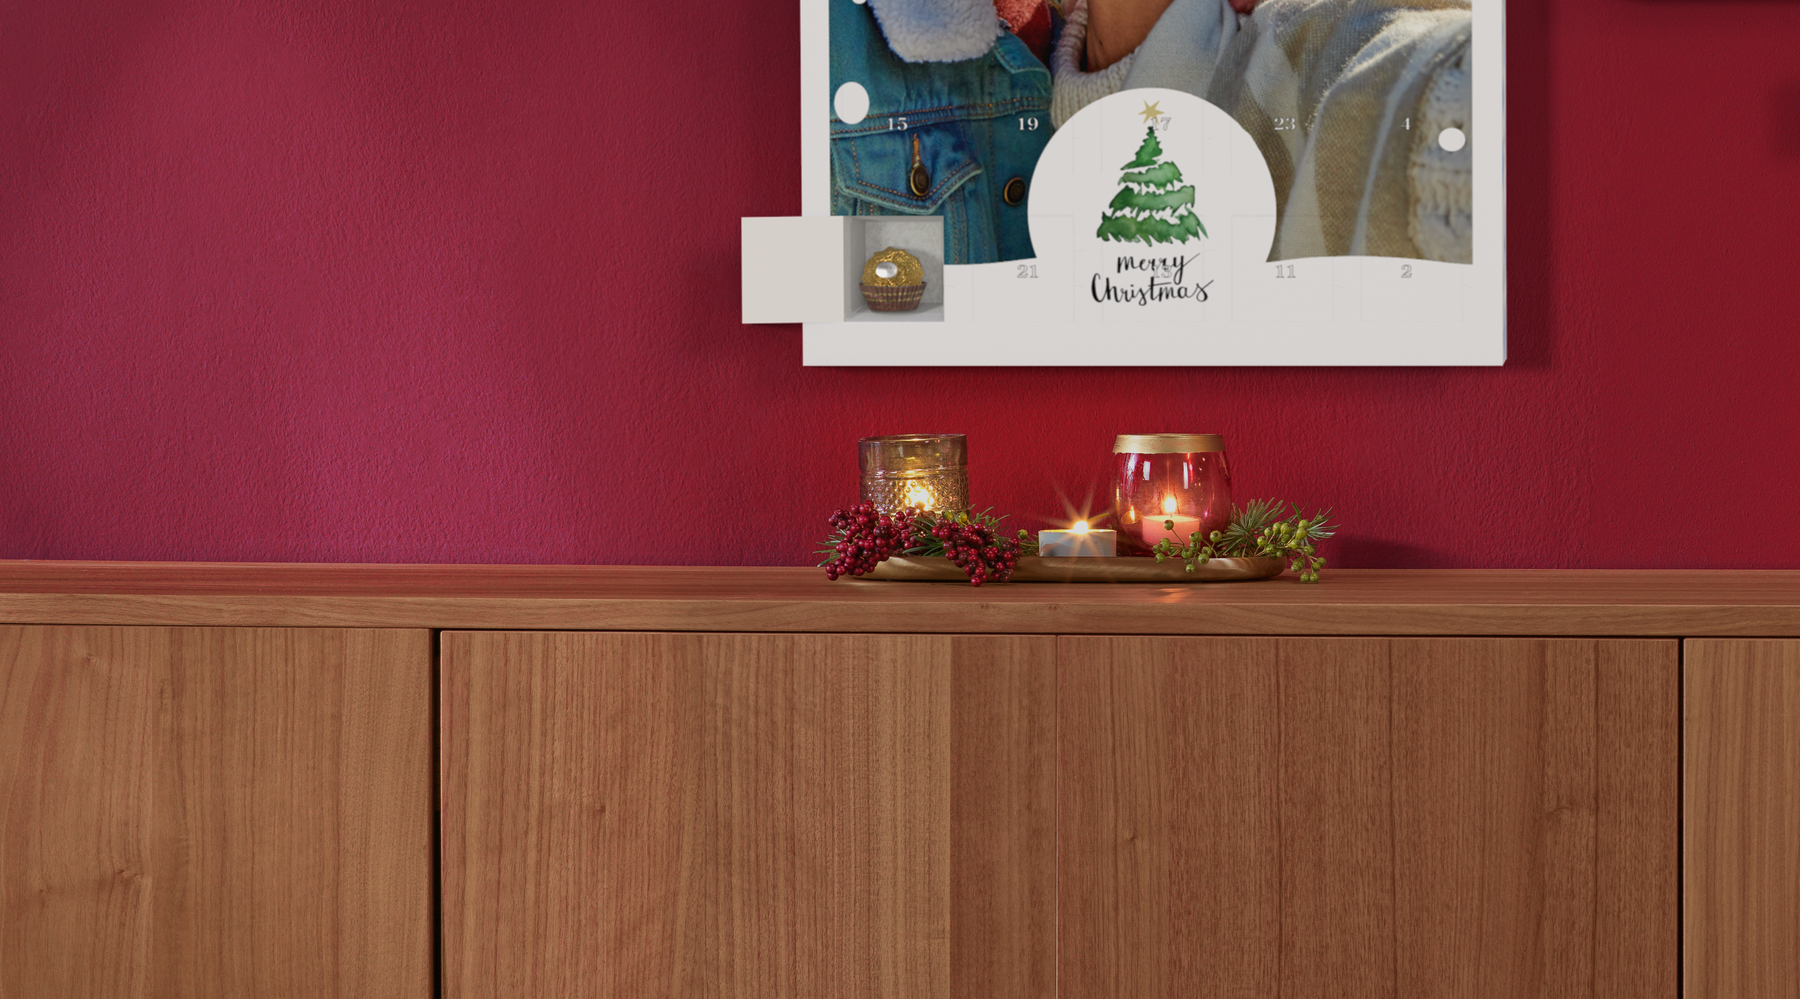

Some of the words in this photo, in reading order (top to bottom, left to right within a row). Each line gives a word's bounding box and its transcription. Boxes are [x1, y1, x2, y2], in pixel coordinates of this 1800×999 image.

[888, 117, 908, 131] 15
[1018, 117, 1039, 131] 19
[1274, 117, 1296, 131] 23
[1400, 117, 1411, 131] 4
[1016, 264, 1038, 279] 21
[1117, 253, 1200, 285] merry
[1275, 264, 1296, 279] 11
[1400, 264, 1413, 279] 2
[1091, 273, 1214, 306] Christmas
